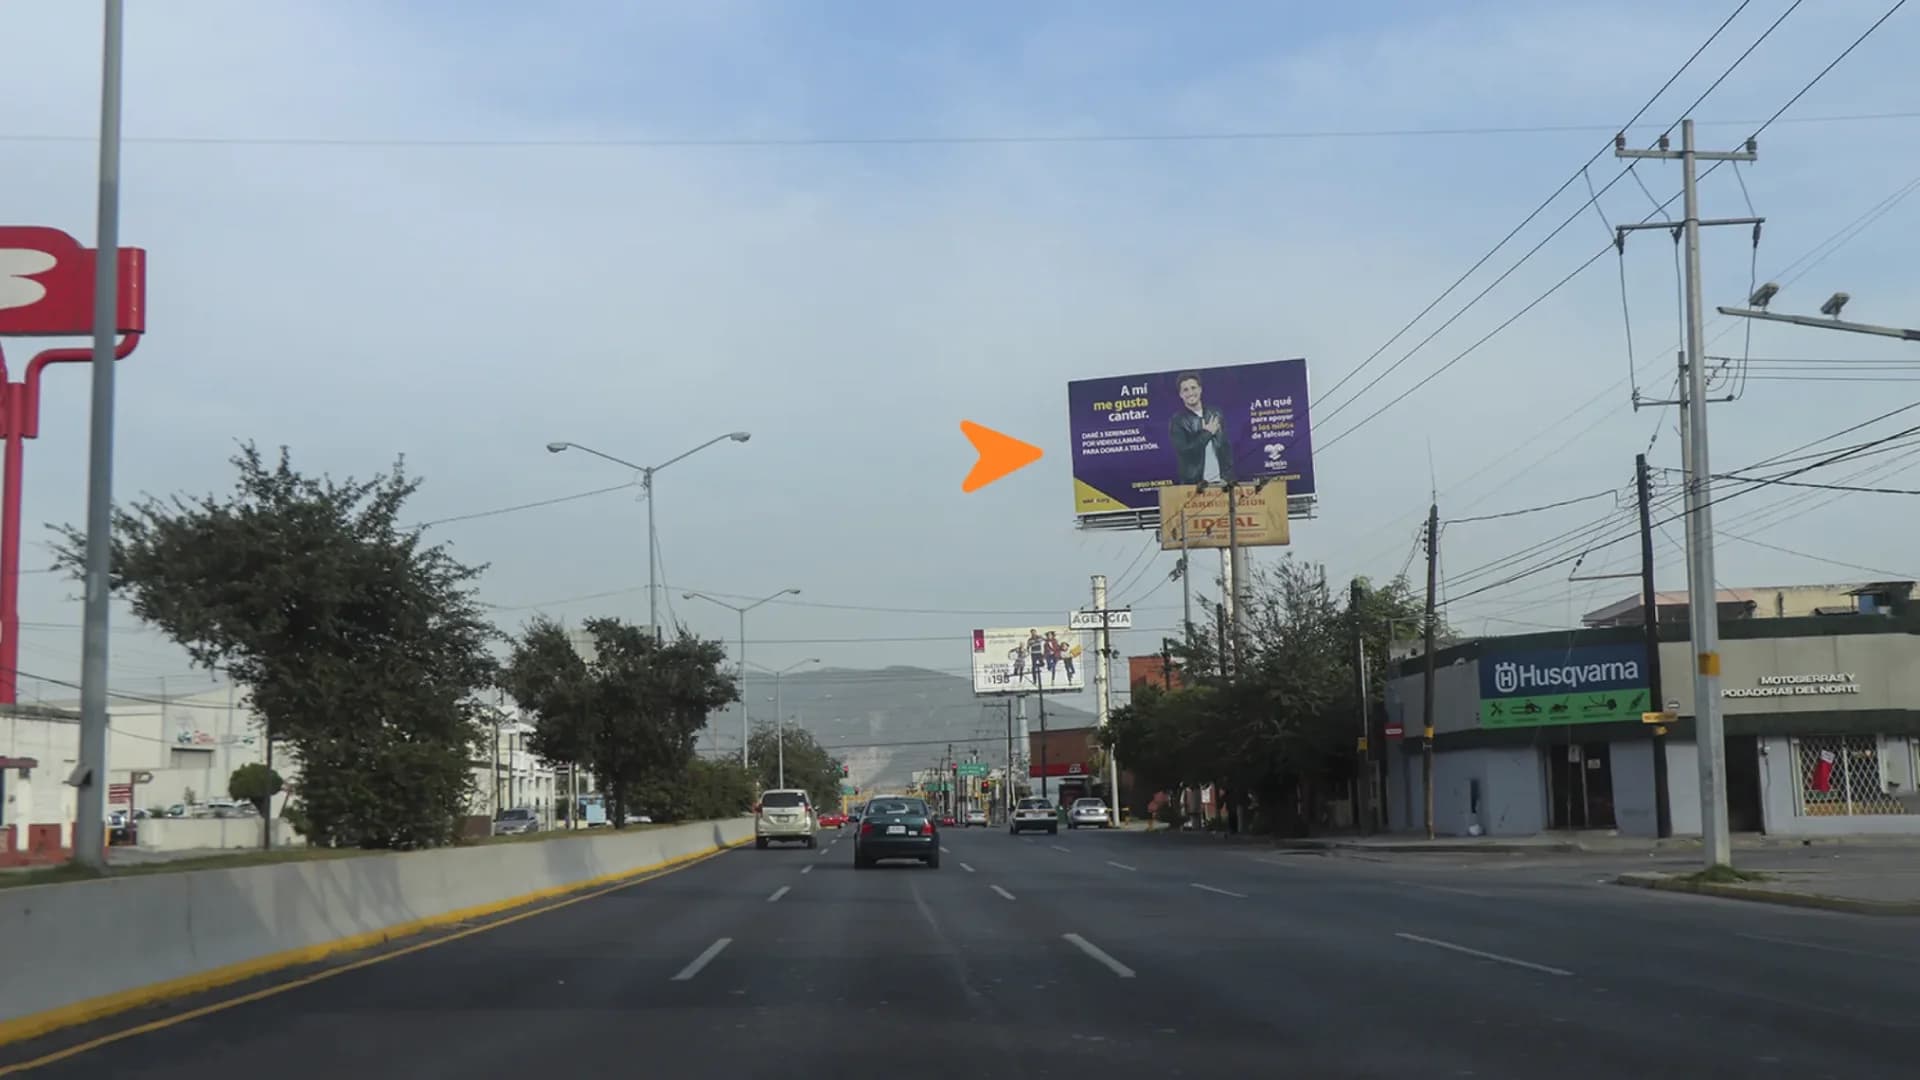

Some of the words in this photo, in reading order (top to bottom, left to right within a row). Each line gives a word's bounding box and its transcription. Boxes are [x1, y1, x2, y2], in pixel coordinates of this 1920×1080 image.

[1121, 385, 1130, 396] A
[1094, 401, 1113, 411] me
[1115, 397, 1148, 411] gusta
[1264, 398, 1271, 407] ti
[1273, 395, 1292, 409] qué
[1108, 410, 1150, 422] cantar.
[1082, 447, 1100, 455] PARA
[1193, 517, 1260, 529] IDEAL
[1519, 661, 1639, 688] Husqvarna
[1720, 686, 1794, 698] PODADORAS
[1795, 685, 1818, 694] DEL
[1820, 684, 1860, 694] NORTE
